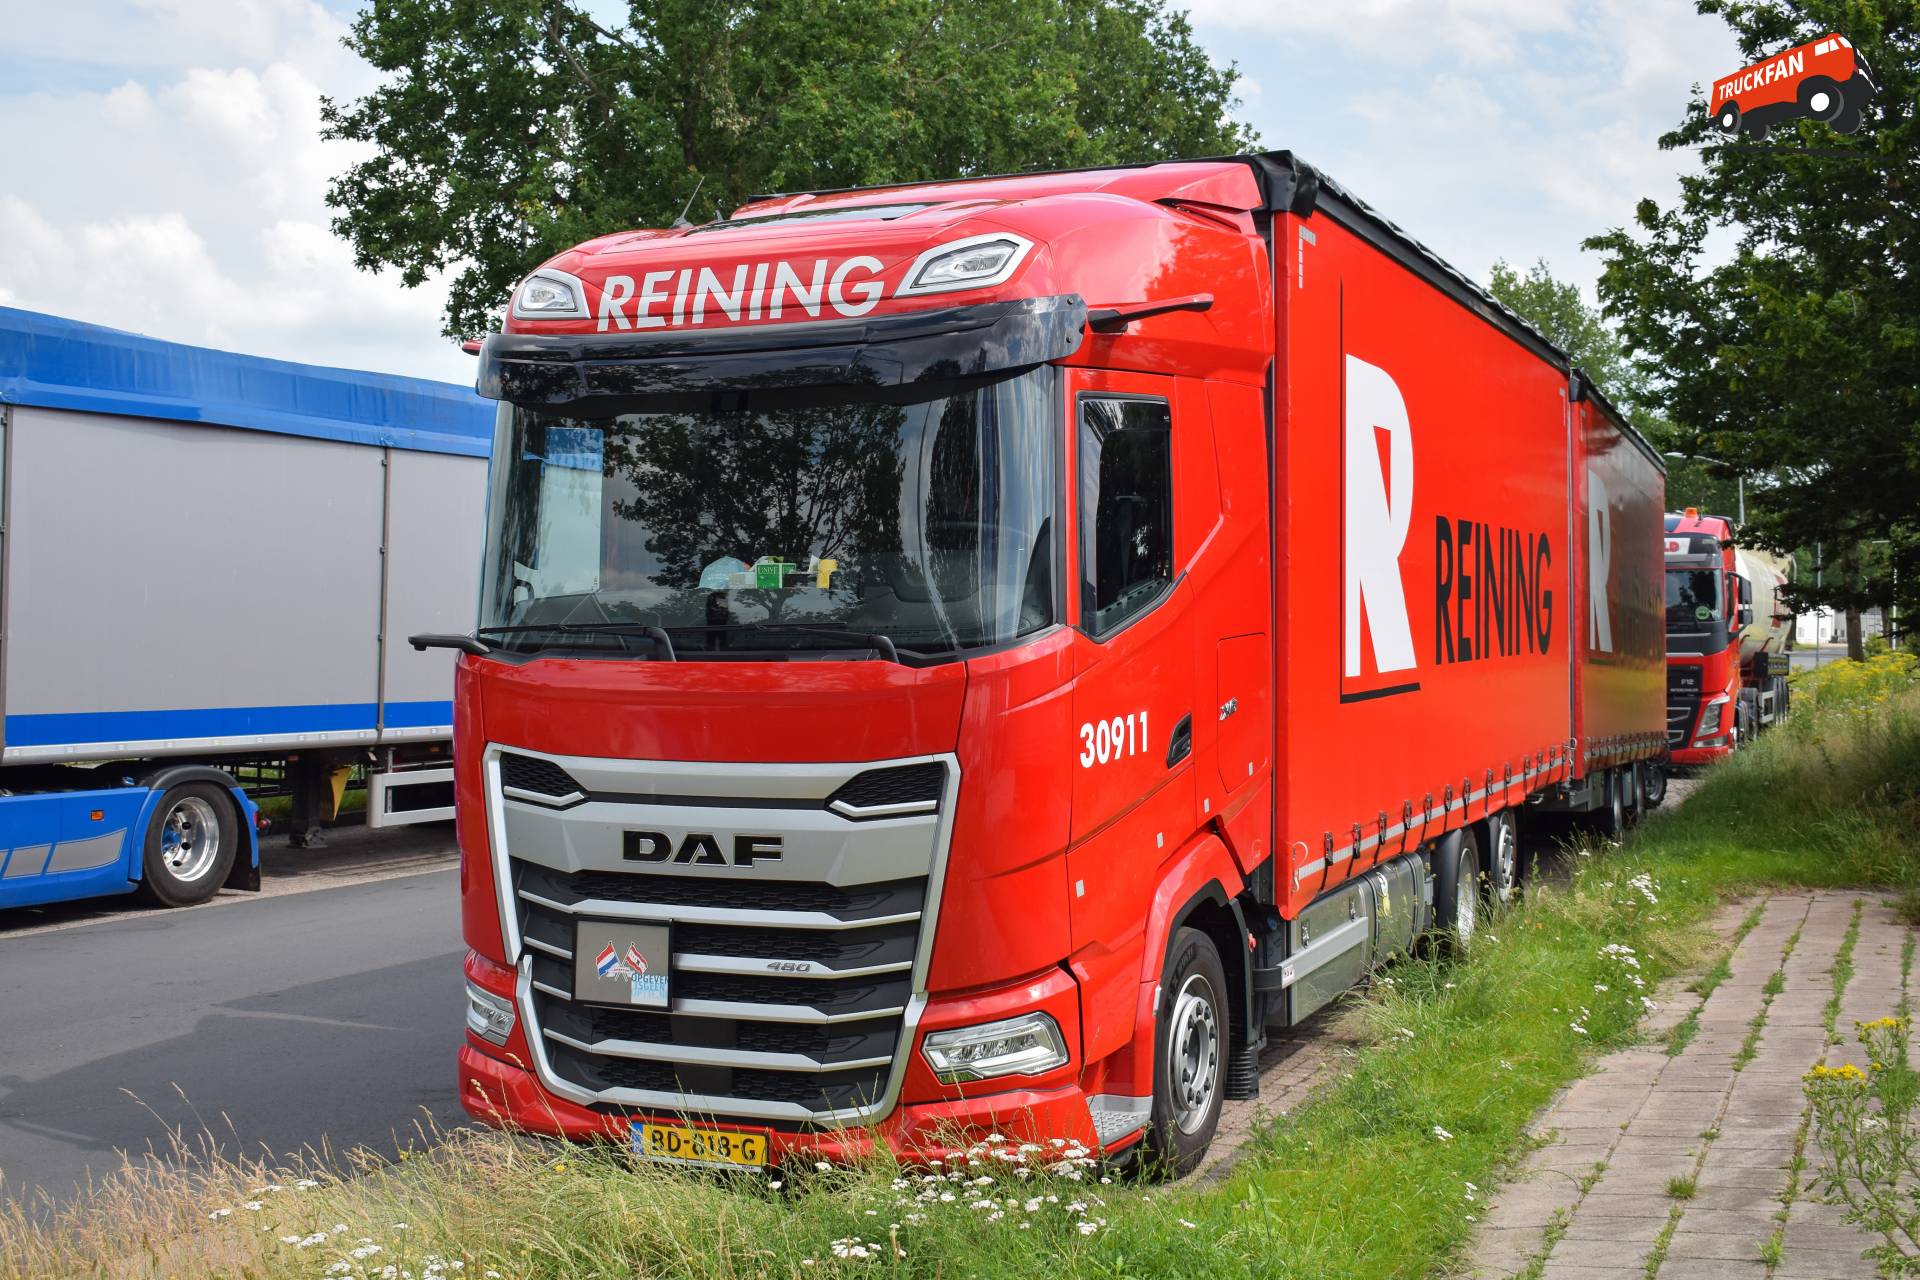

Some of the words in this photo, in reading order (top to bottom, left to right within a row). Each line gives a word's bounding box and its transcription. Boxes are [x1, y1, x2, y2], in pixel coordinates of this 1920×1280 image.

[596, 255, 885, 333] REINING
[1345, 352, 1419, 678] R
[1436, 515, 1553, 665] REINING
[1588, 469, 1614, 653] R
[1079, 711, 1148, 768] 30911
[622, 828, 785, 868] DAF
[767, 961, 811, 973] 480
[652, 1129, 757, 1161] BD-818-G
